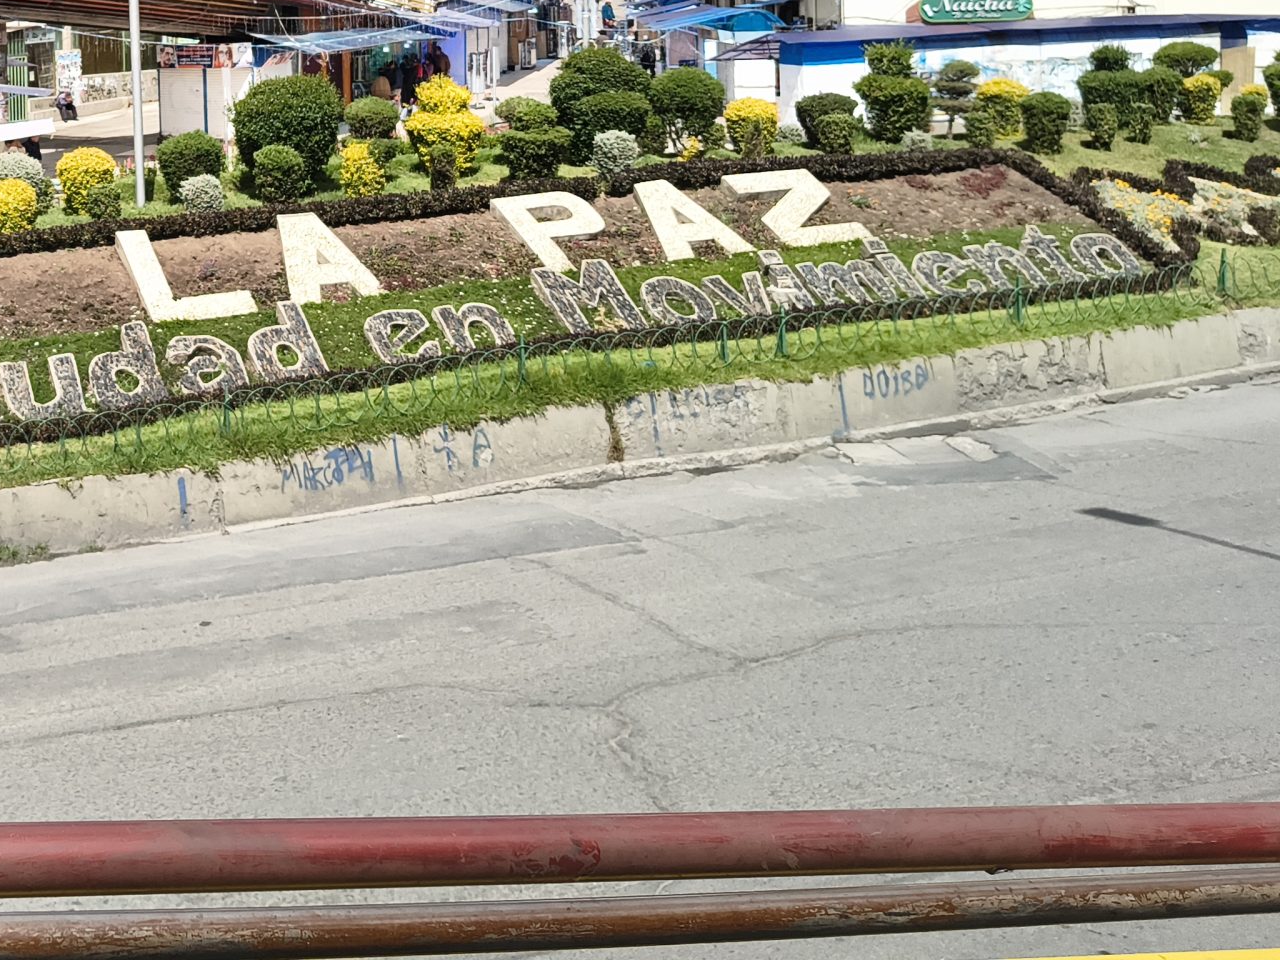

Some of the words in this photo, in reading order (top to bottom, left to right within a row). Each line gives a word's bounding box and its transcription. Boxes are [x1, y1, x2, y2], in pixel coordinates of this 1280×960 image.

[114, 212, 386, 321] LA
[490, 169, 874, 272] PAZ
[363, 302, 517, 367] en
[530, 224, 1142, 335] Movimiento
